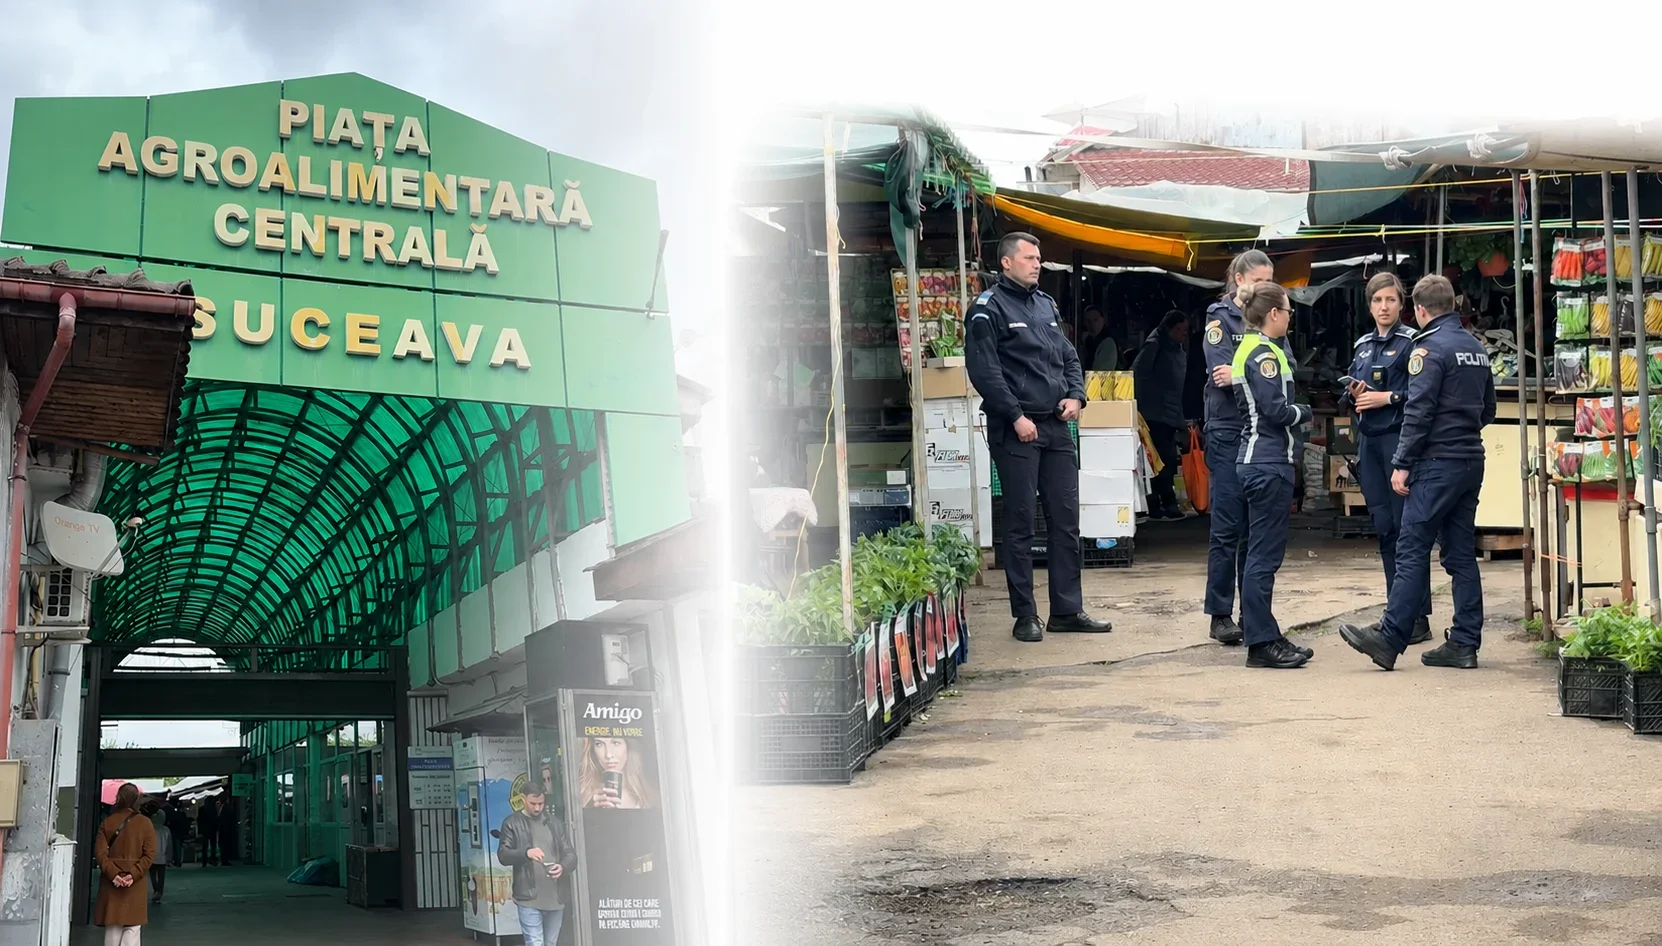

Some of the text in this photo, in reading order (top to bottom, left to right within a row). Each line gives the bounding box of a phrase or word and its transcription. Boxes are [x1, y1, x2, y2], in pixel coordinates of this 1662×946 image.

[97, 131, 593, 230] AGROALIMENTARĂ
[213, 203, 500, 275] CENTRALĂ
[191, 296, 532, 370] SUCEAVA
[88, 524, 99, 533] TV
[583, 702, 642, 724] Amigo
